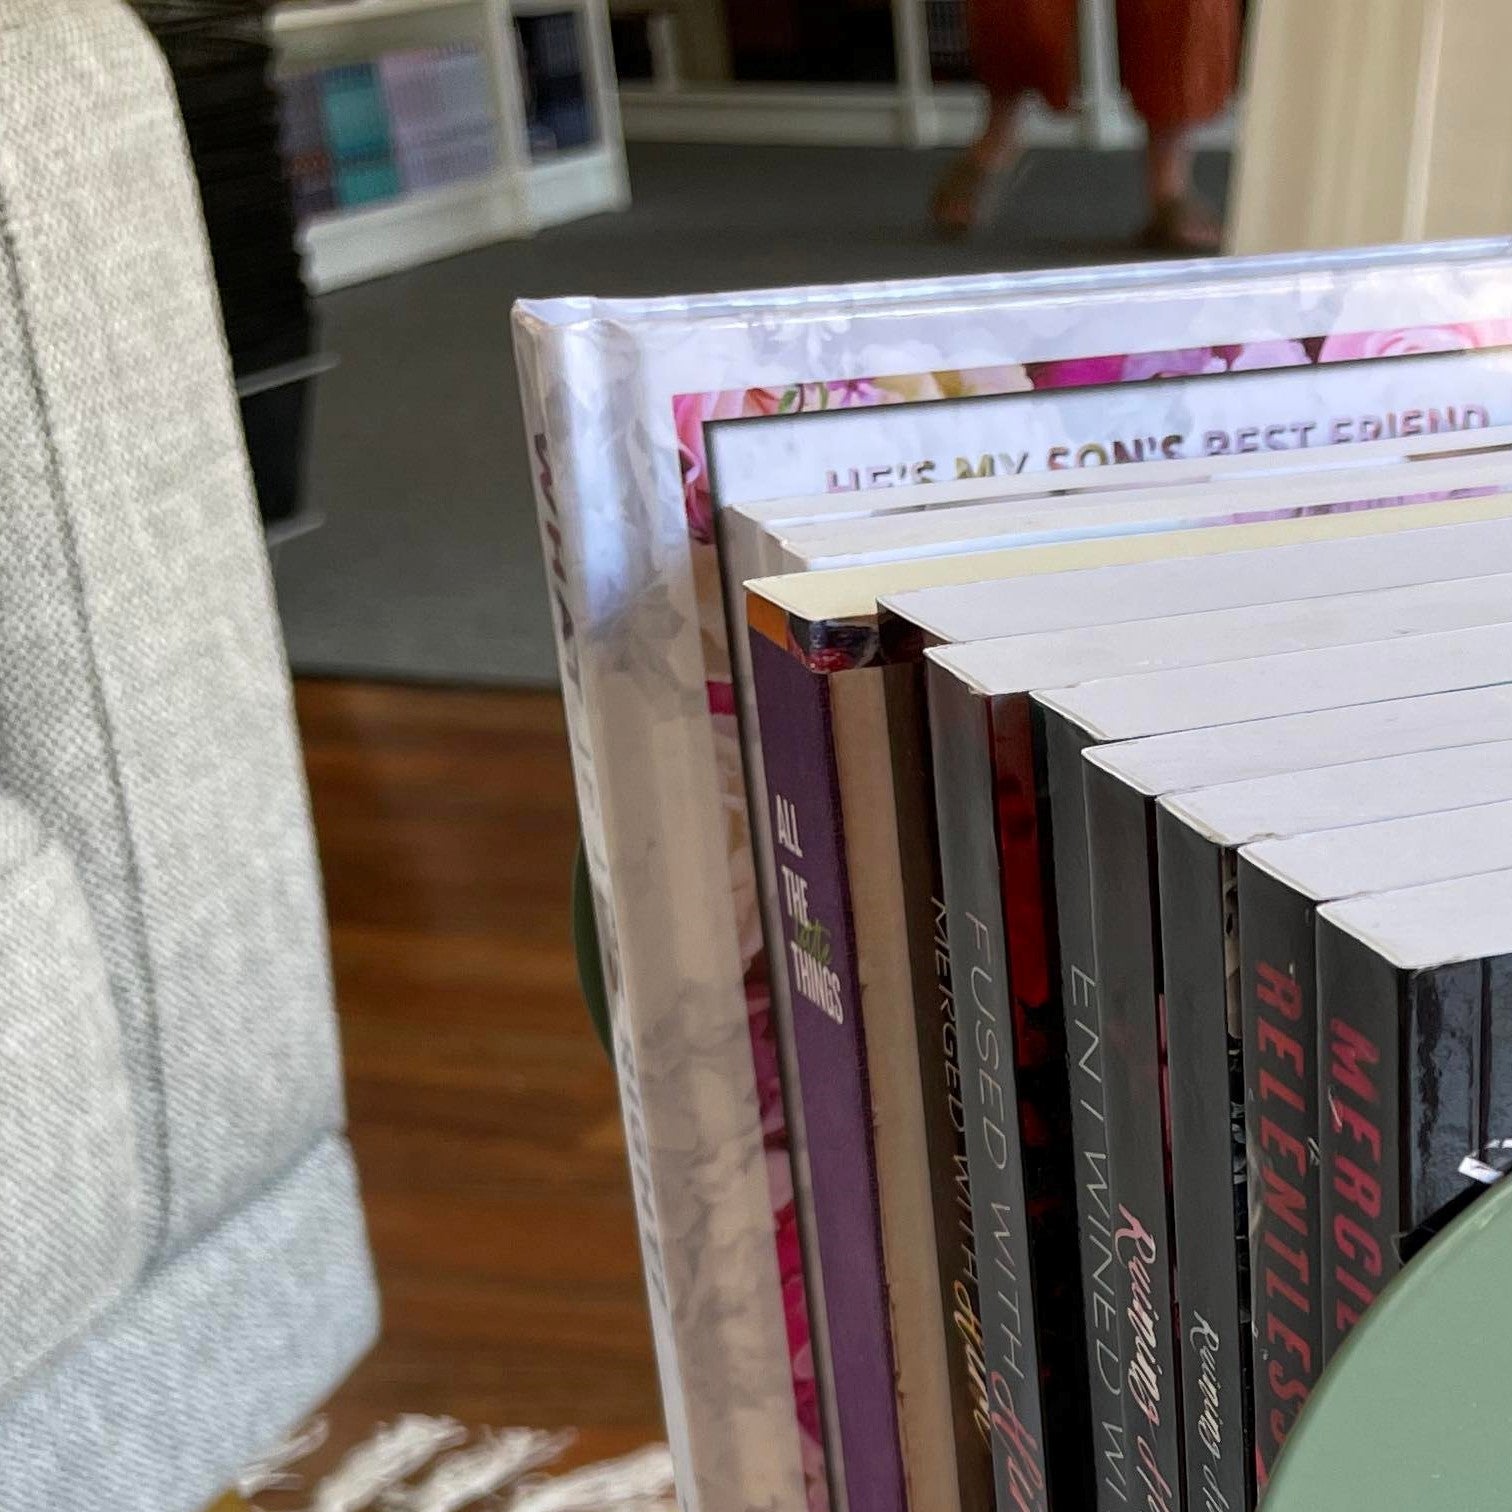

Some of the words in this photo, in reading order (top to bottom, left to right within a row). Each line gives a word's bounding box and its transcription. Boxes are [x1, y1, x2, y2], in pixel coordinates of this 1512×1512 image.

[534, 431, 583, 705] WHAT
[826, 459, 935, 494] HE'S
[955, 450, 1029, 480] MY
[775, 793, 804, 859] ALL
[781, 864, 809, 926] THE
[790, 940, 844, 1026] THINGS
[931, 895, 967, 1136] MERGED
[952, 1152, 979, 1282] WITH
[965, 911, 1008, 1171] FUSED
[990, 1201, 1025, 1381] WITH
[1070, 964, 1122, 1397] ENTWINED
[1115, 1202, 1161, 1450] Ruining
[1189, 1309, 1223, 1474] Ruining
